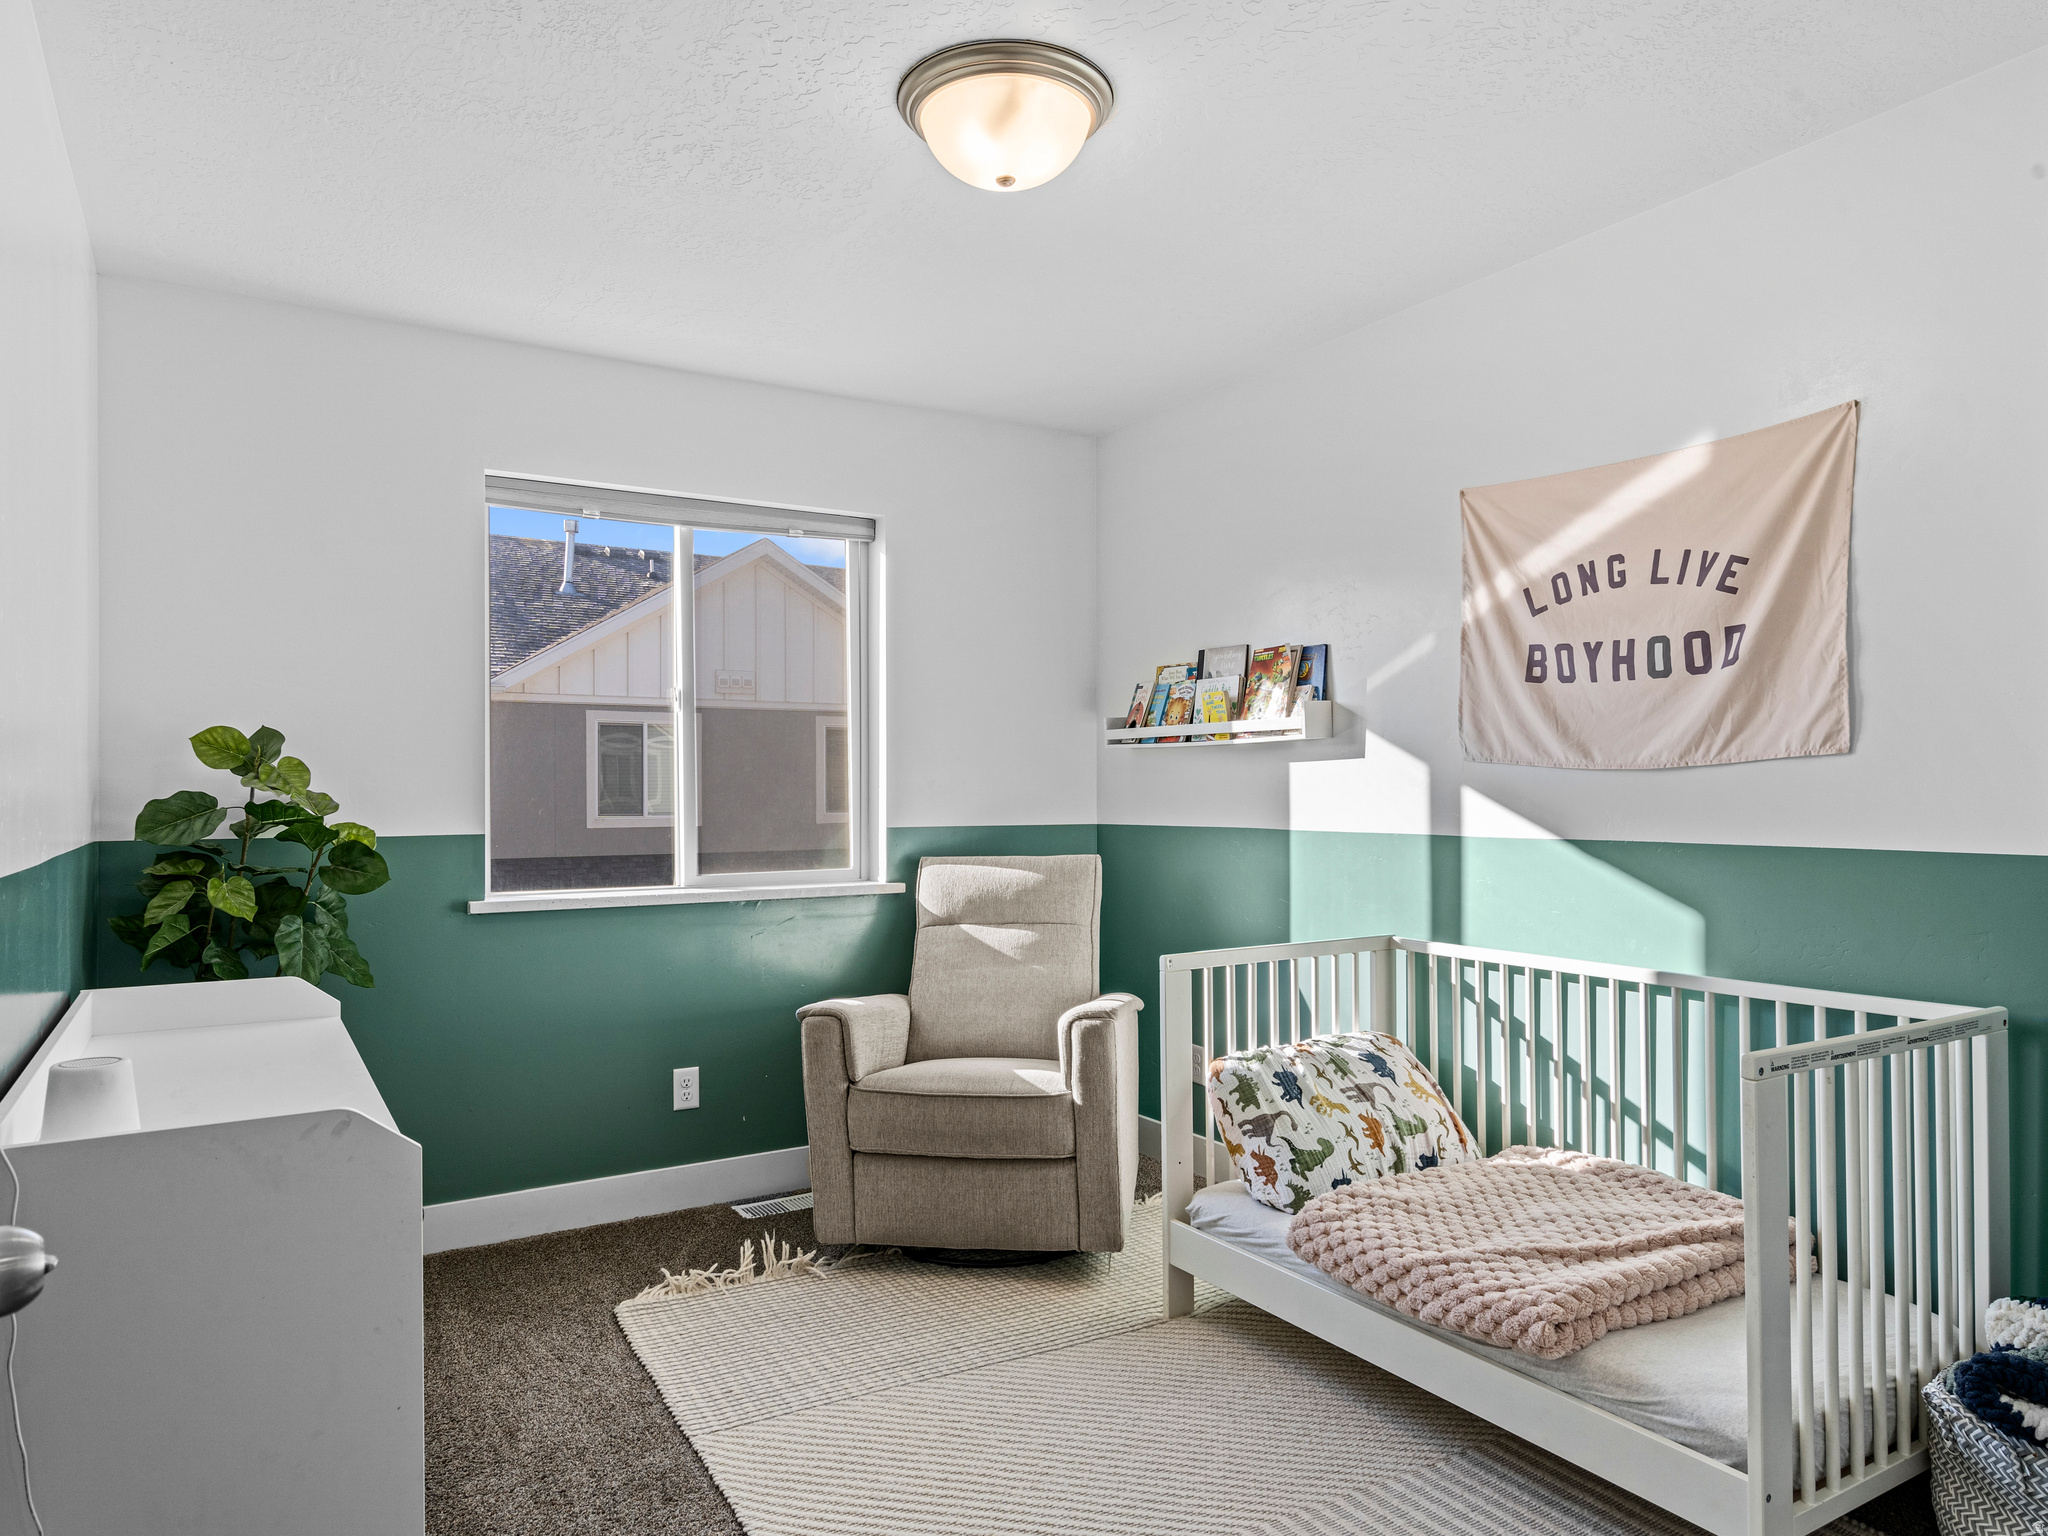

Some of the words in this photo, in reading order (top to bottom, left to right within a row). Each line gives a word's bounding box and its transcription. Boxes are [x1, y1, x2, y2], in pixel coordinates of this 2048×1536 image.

[1522, 553, 1627, 617] LONG
[1650, 549, 1750, 595] LIVE
[1524, 624, 1747, 684] BOYHOOD
[1907, 1036, 1929, 1045] ADVERTENCIA
[1770, 1063, 1790, 1072] WARNING
